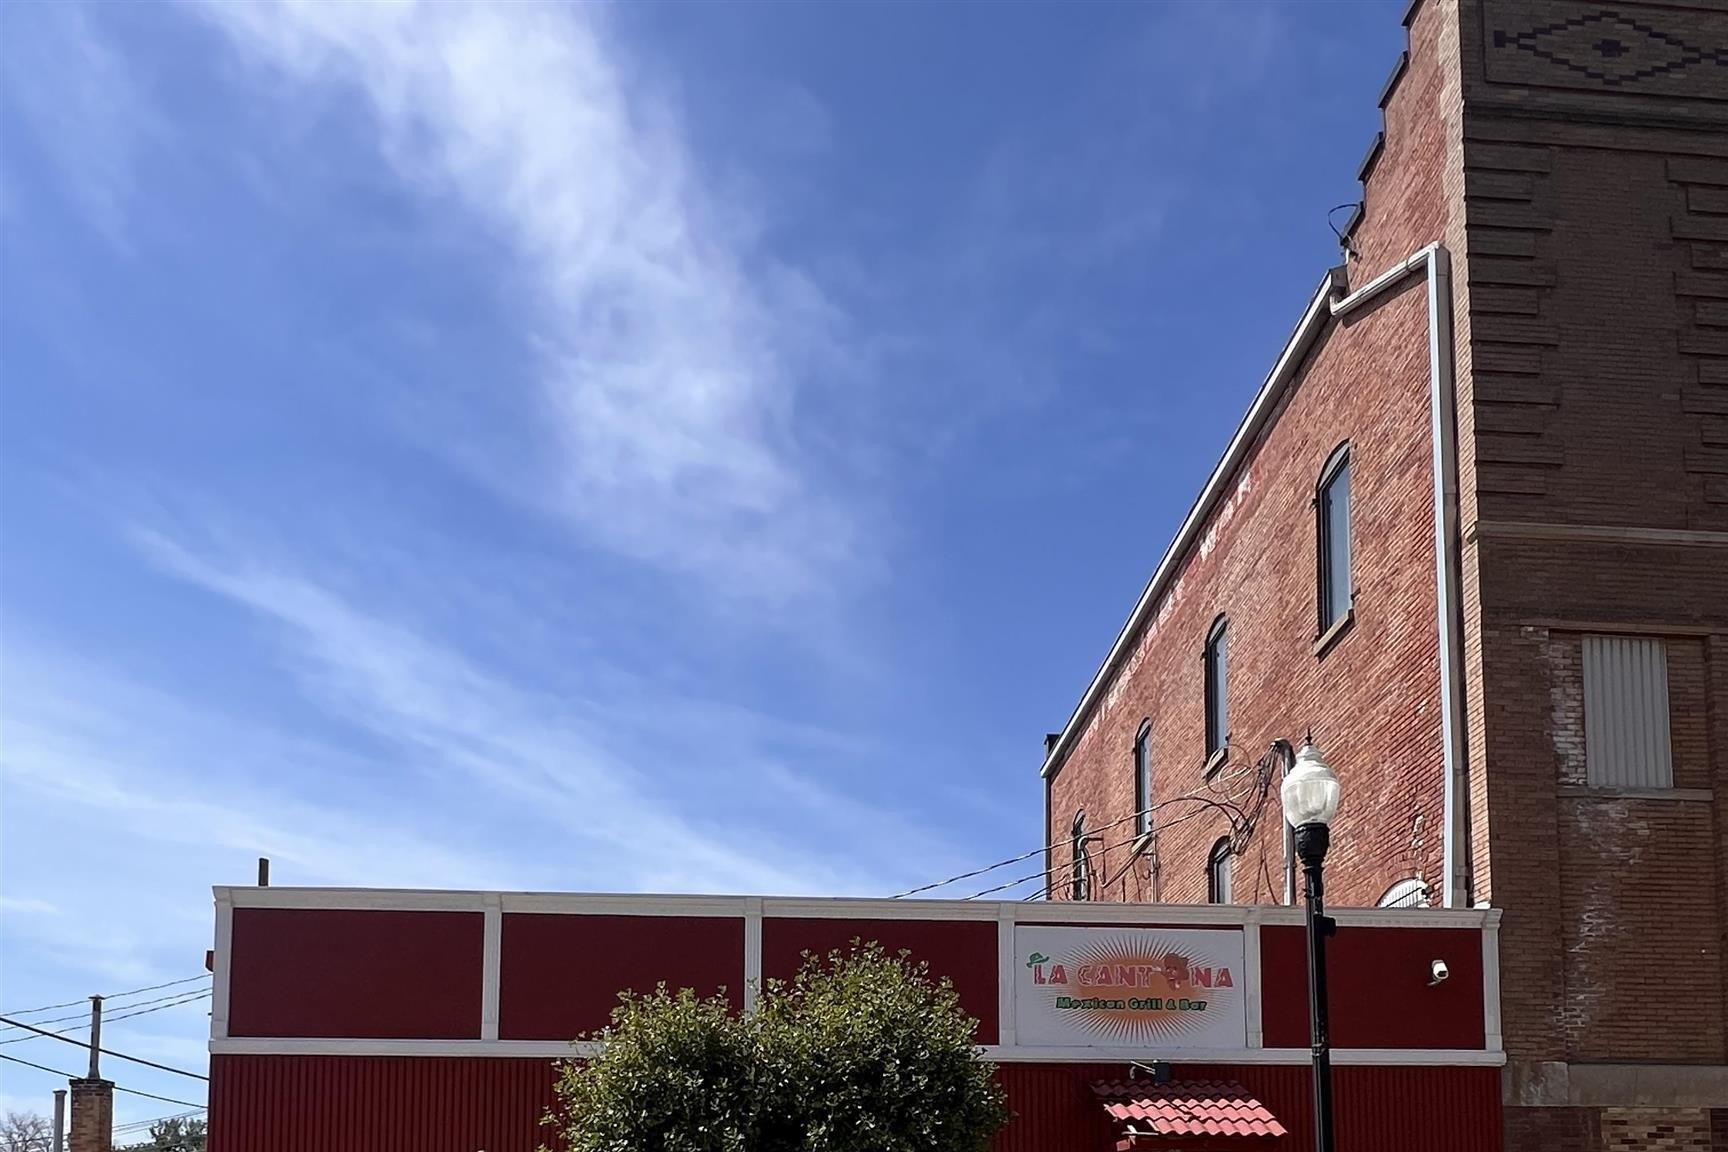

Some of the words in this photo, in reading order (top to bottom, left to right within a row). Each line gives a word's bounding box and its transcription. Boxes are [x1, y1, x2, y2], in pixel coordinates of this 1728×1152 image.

[1033, 965, 1067, 985] LA
[1056, 997, 1126, 1009] Mexican
[1128, 998, 1162, 1010] Grill
[1166, 999, 1176, 1010] &
[1179, 999, 1207, 1011] Bar
